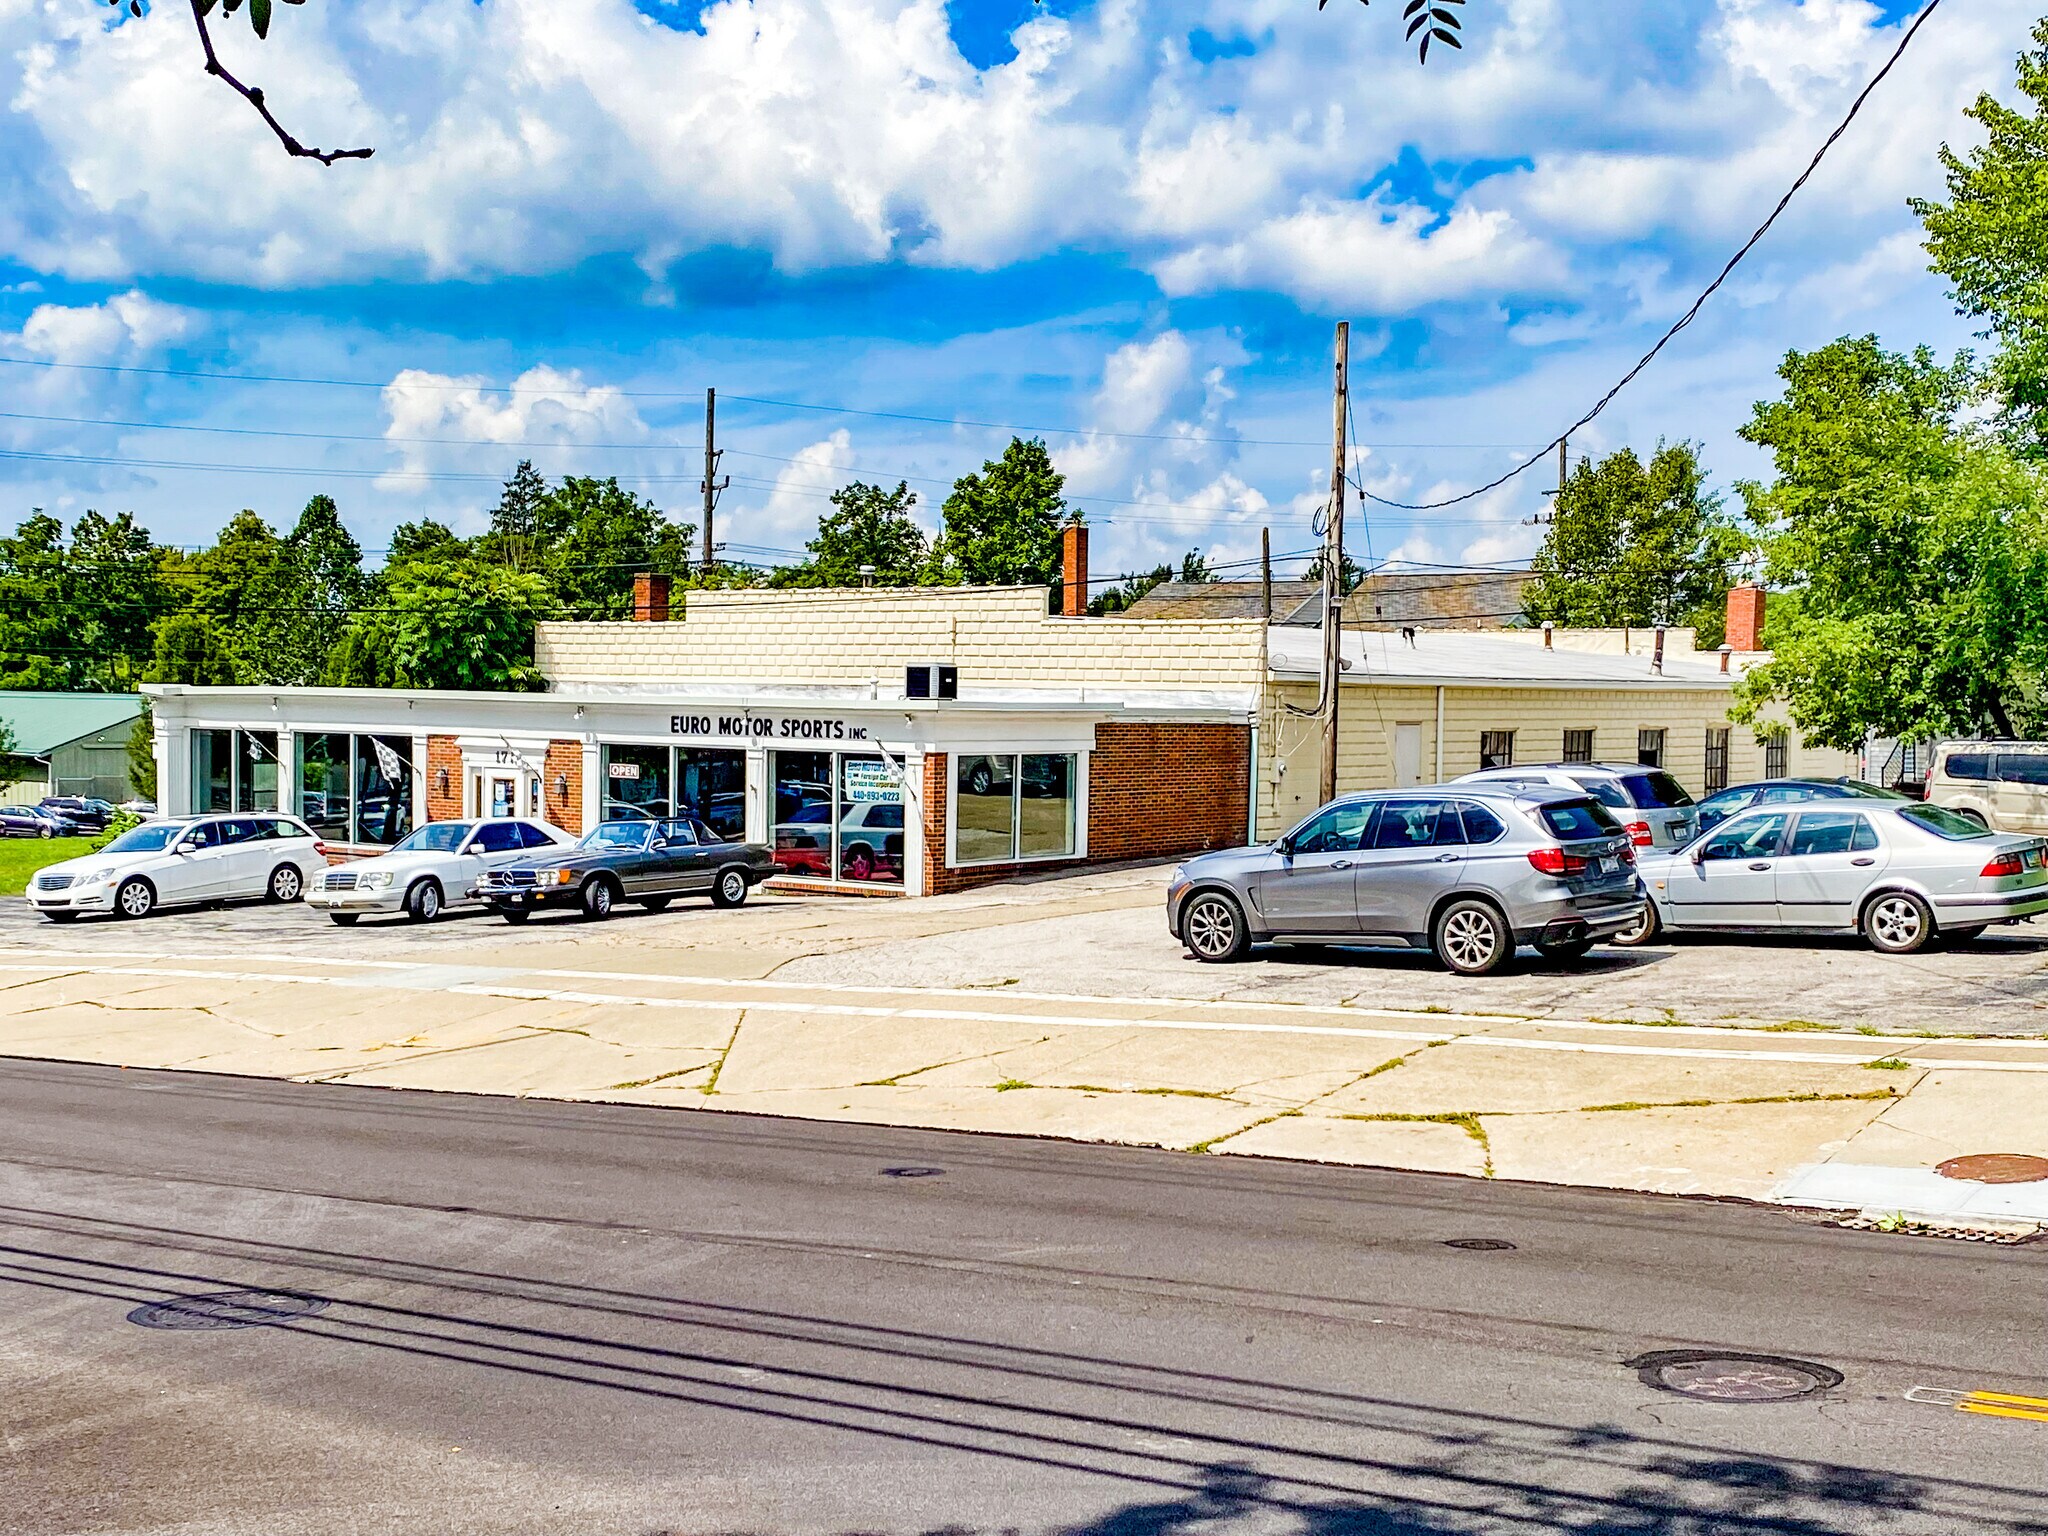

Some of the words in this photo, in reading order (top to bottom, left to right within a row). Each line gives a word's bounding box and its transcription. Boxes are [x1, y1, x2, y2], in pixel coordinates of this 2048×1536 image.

[670, 715, 711, 734] EURO
[718, 716, 773, 736] MOTOR
[780, 718, 844, 739] SPORTS
[848, 727, 867, 739] INC
[611, 765, 637, 777] OPEN
[853, 791, 900, 801] 440-893-0223
